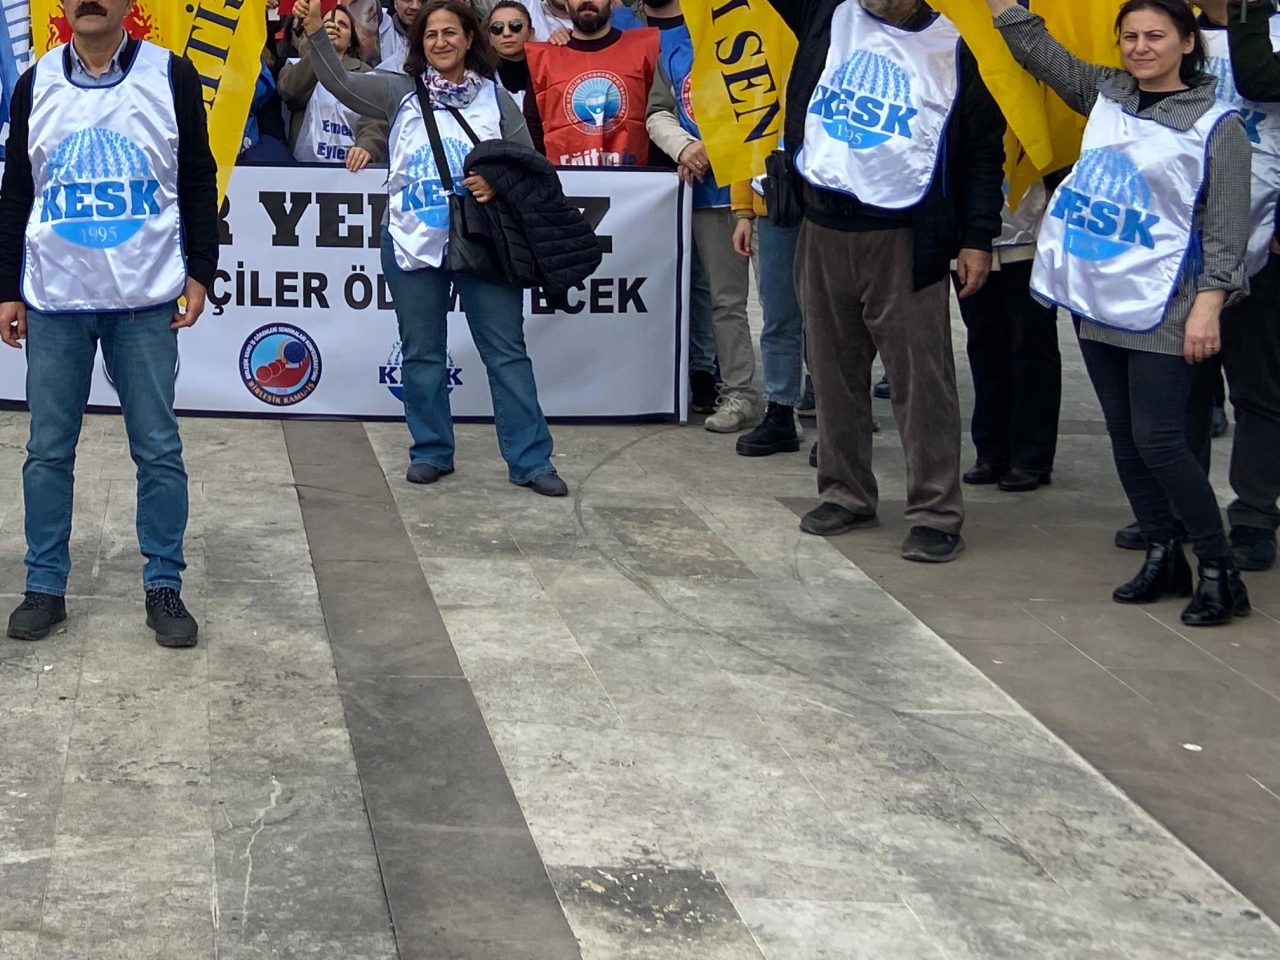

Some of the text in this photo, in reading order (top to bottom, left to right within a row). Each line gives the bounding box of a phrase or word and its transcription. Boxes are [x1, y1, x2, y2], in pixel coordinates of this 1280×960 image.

[715, 29, 782, 144] SEN
[809, 84, 918, 139] KESK
[317, 142, 347, 160] Eyle
[40, 179, 161, 223] KESK
[80, 226, 118, 243] 1995
[207, 261, 330, 315] ÇİLER
